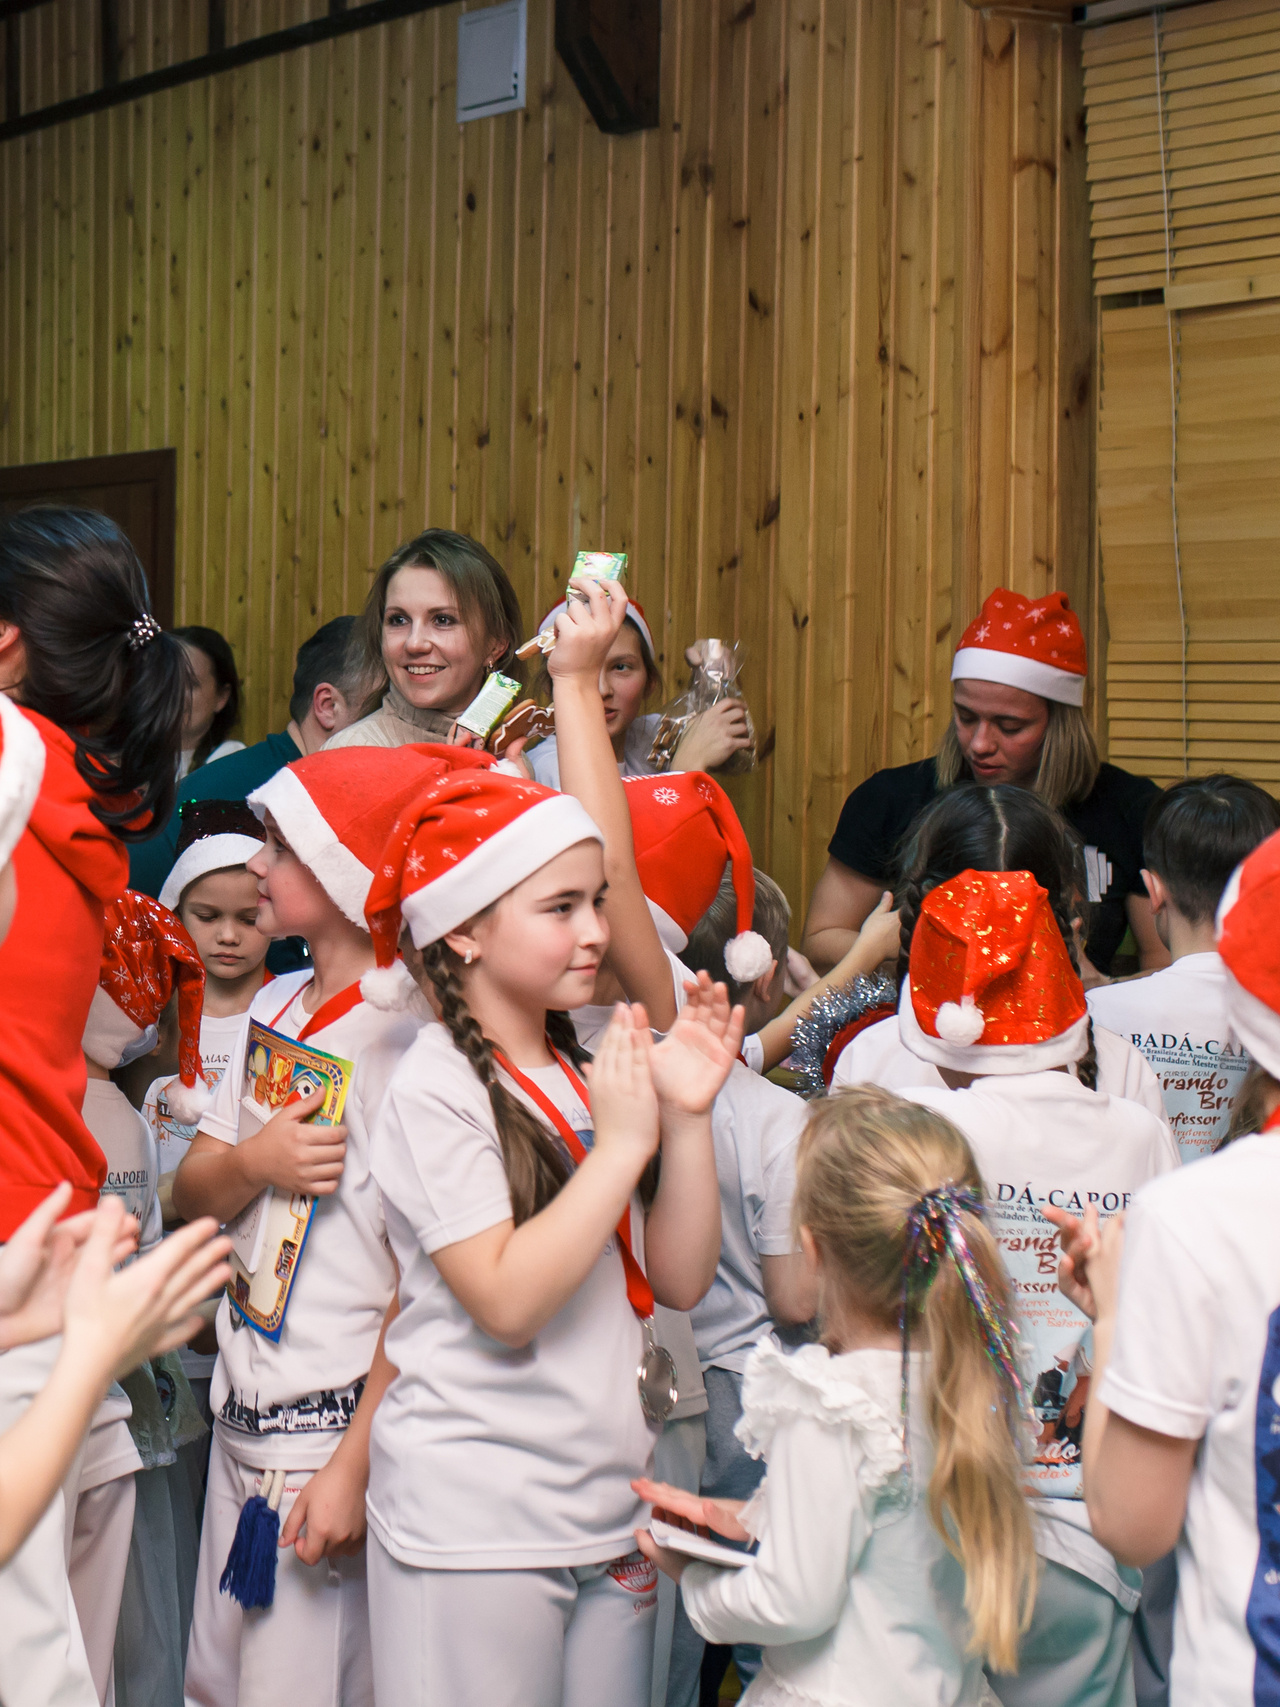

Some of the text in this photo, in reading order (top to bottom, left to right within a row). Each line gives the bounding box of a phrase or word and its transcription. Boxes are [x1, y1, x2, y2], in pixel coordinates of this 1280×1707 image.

[1146, 1048, 1178, 1057] Brasileira
[1188, 1053, 1208, 1062] Apoio
[1151, 1056, 1191, 1066] Fundador:
[1193, 1058, 1218, 1069] Mestre
